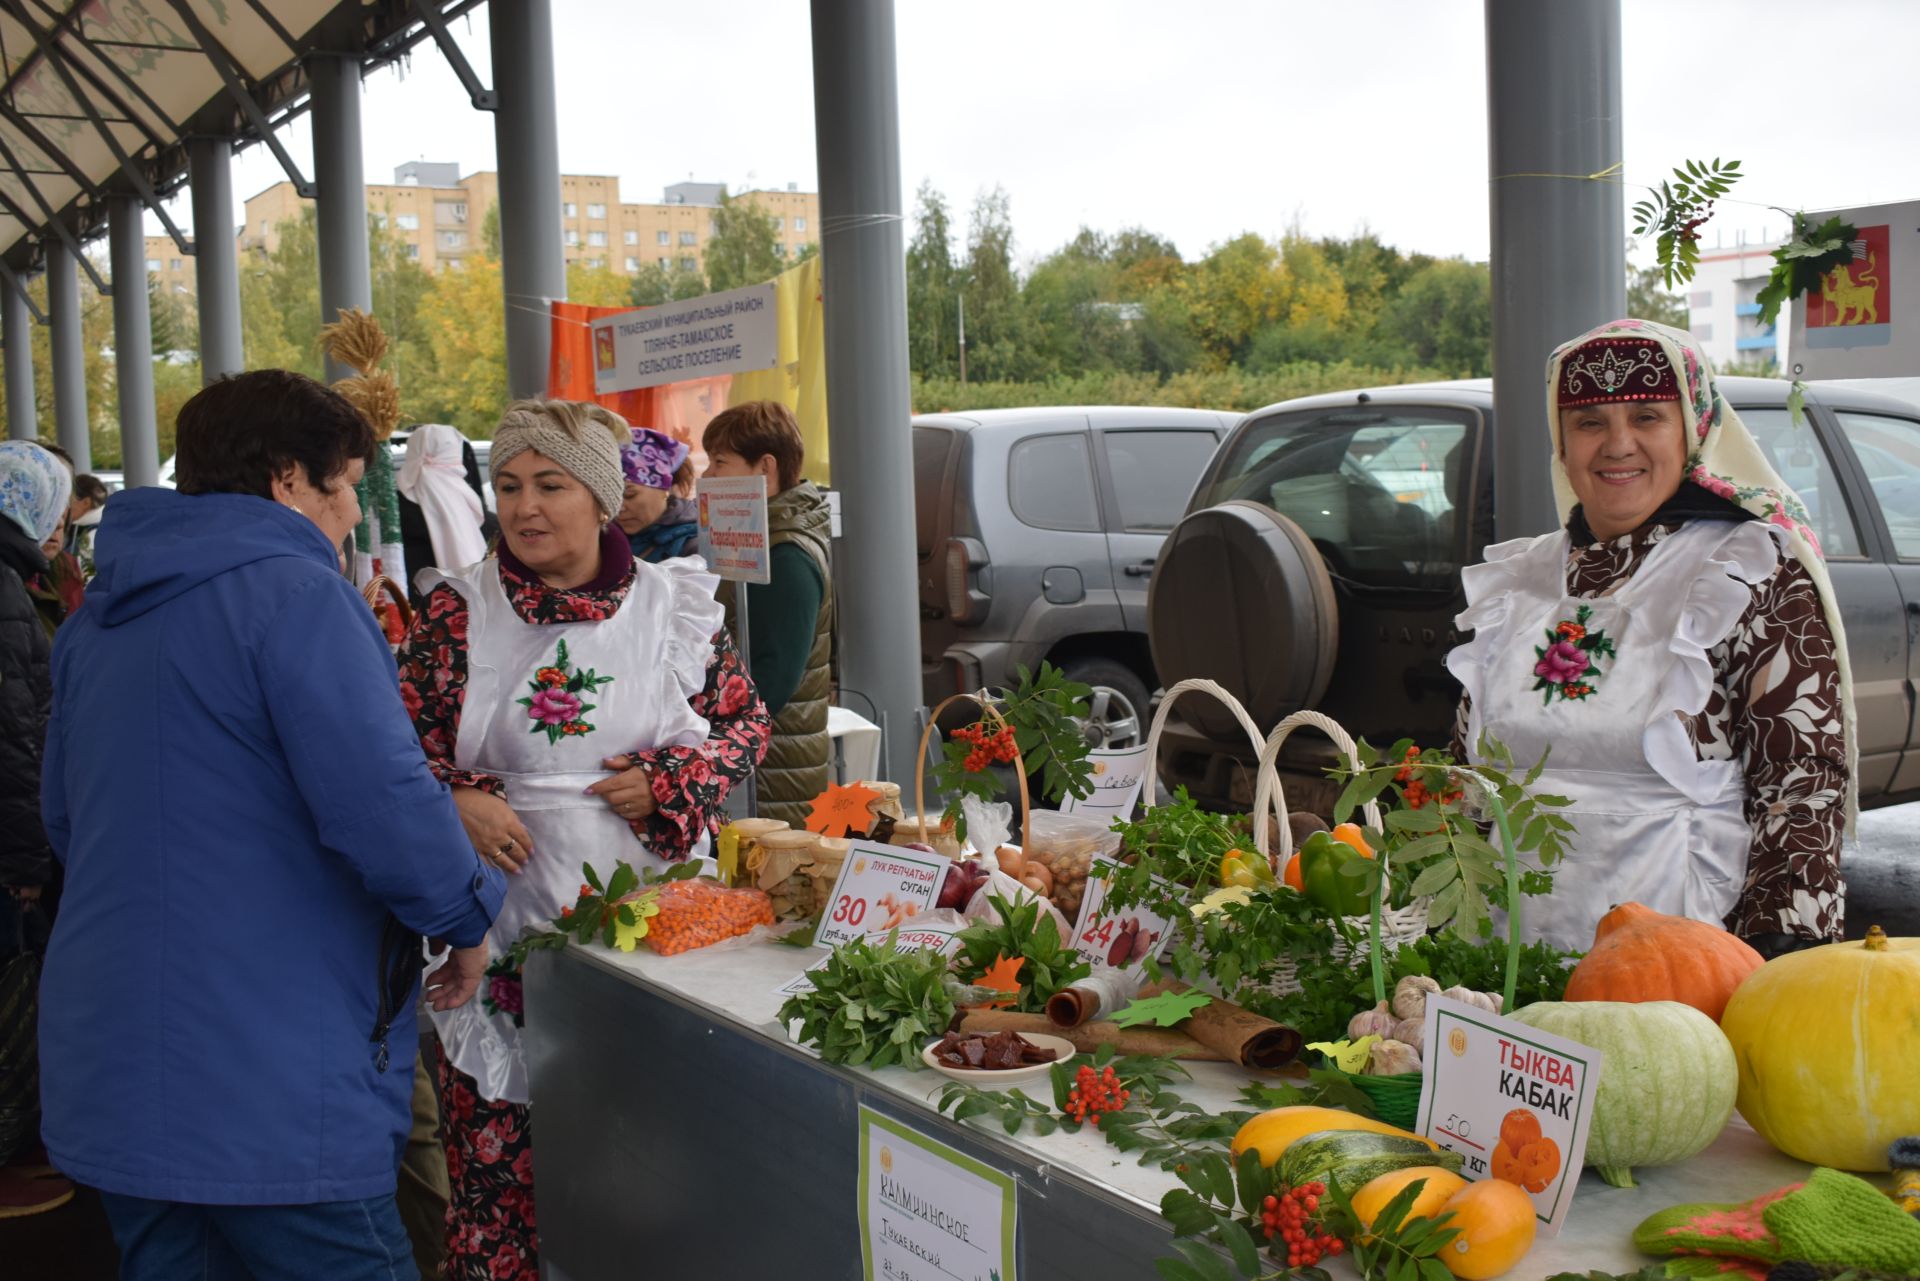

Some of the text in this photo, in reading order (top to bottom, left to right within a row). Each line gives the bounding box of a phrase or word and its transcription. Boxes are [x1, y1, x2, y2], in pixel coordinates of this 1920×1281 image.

[619, 297, 764, 337] ТУКАЕВСКИЙ МУНИЦИПАЛЬНЫЙ РАЙОН
[644, 324, 735, 353] ТЛЯНЧЕ-ТАМАКСКОЕ
[638, 344, 742, 376] СЕЛЬСКОЕ ПОСЕЛЕНИЕ
[871, 861, 936, 883] ЛУК РЕПЧАТЫЙ
[900, 881, 931, 897] СУГАН
[833, 895, 867, 926] 30
[877, 933, 944, 948] МРКОВЬ
[1081, 911, 1114, 949] 24
[1498, 1038, 1575, 1091] ТЫКВА
[1499, 1069, 1574, 1121] КАБАК
[1446, 1114, 1471, 1137] 50
